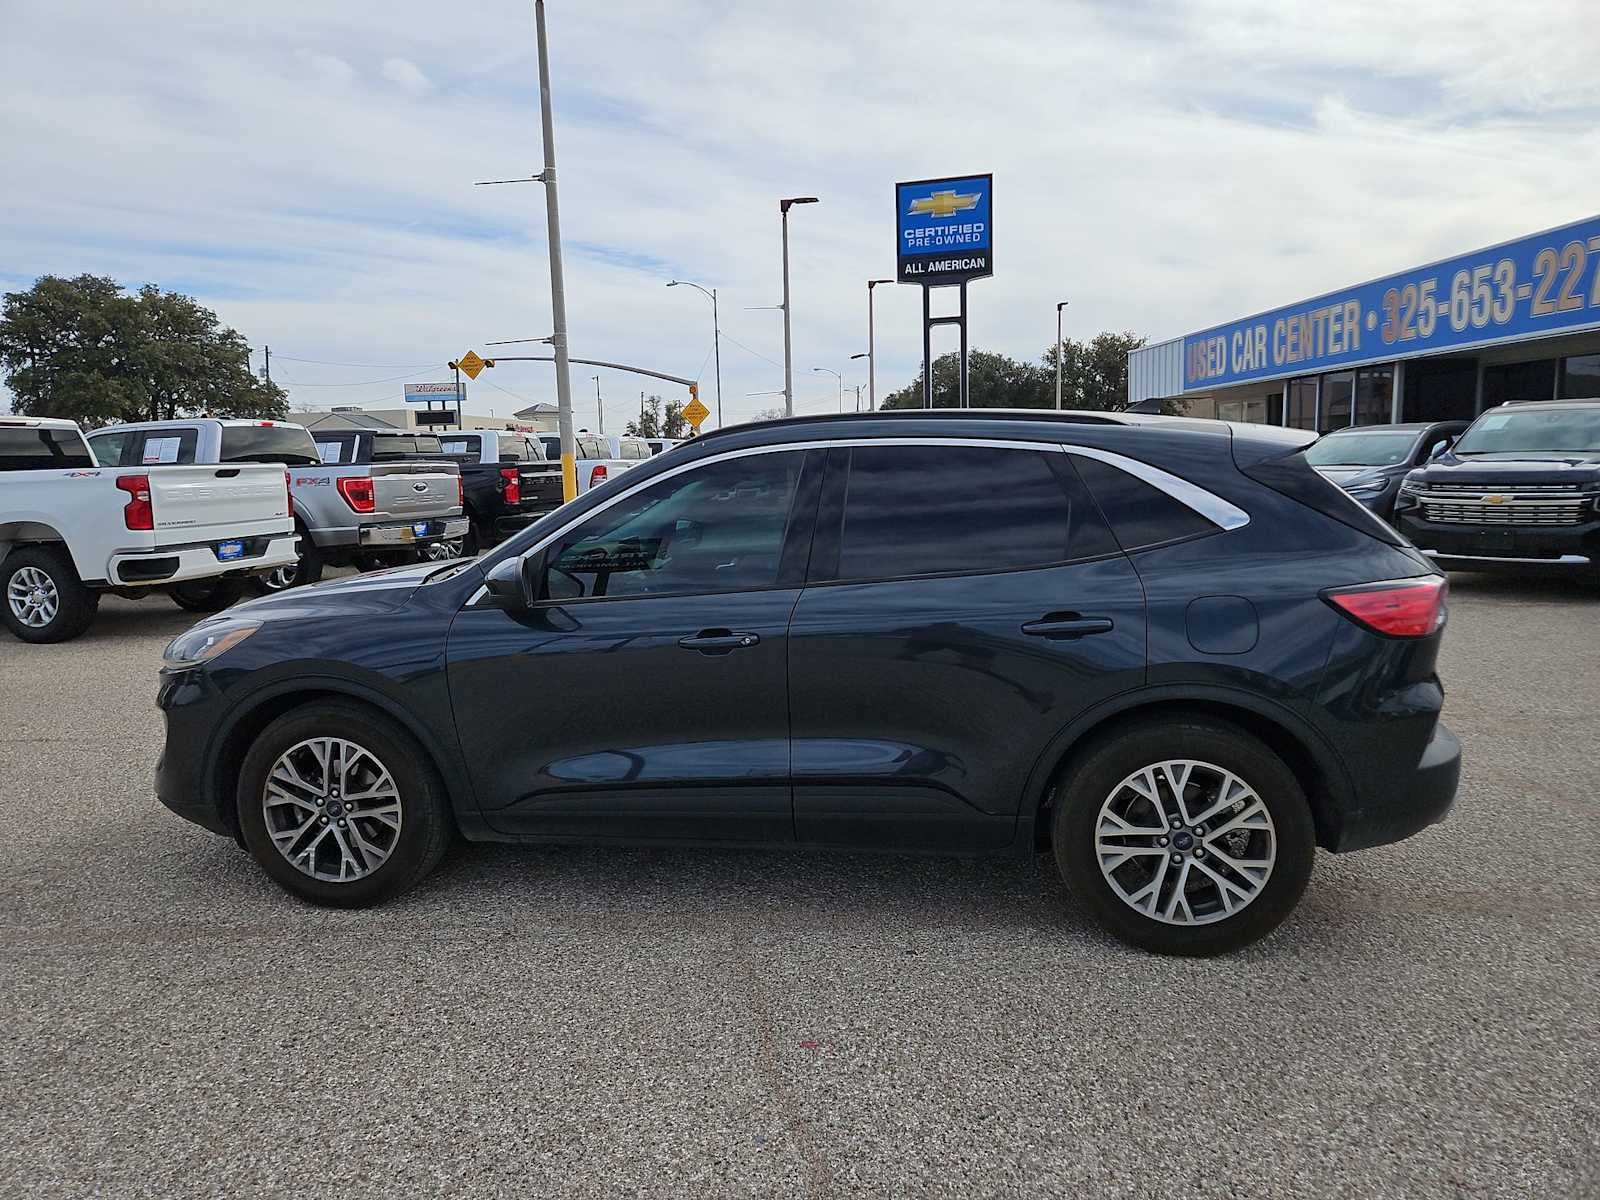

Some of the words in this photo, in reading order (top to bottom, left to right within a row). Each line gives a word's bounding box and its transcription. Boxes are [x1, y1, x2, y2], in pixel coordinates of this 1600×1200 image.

[904, 222, 984, 239] CERTIFIED
[908, 233, 980, 248] PRE-OWNED
[905, 263, 925, 274] ALL
[928, 258, 985, 272] AMERICAN
[1187, 335, 1227, 383] USED
[1232, 324, 1267, 374] CAR
[1274, 299, 1360, 366] CENTER
[295, 476, 331, 487] FX4
